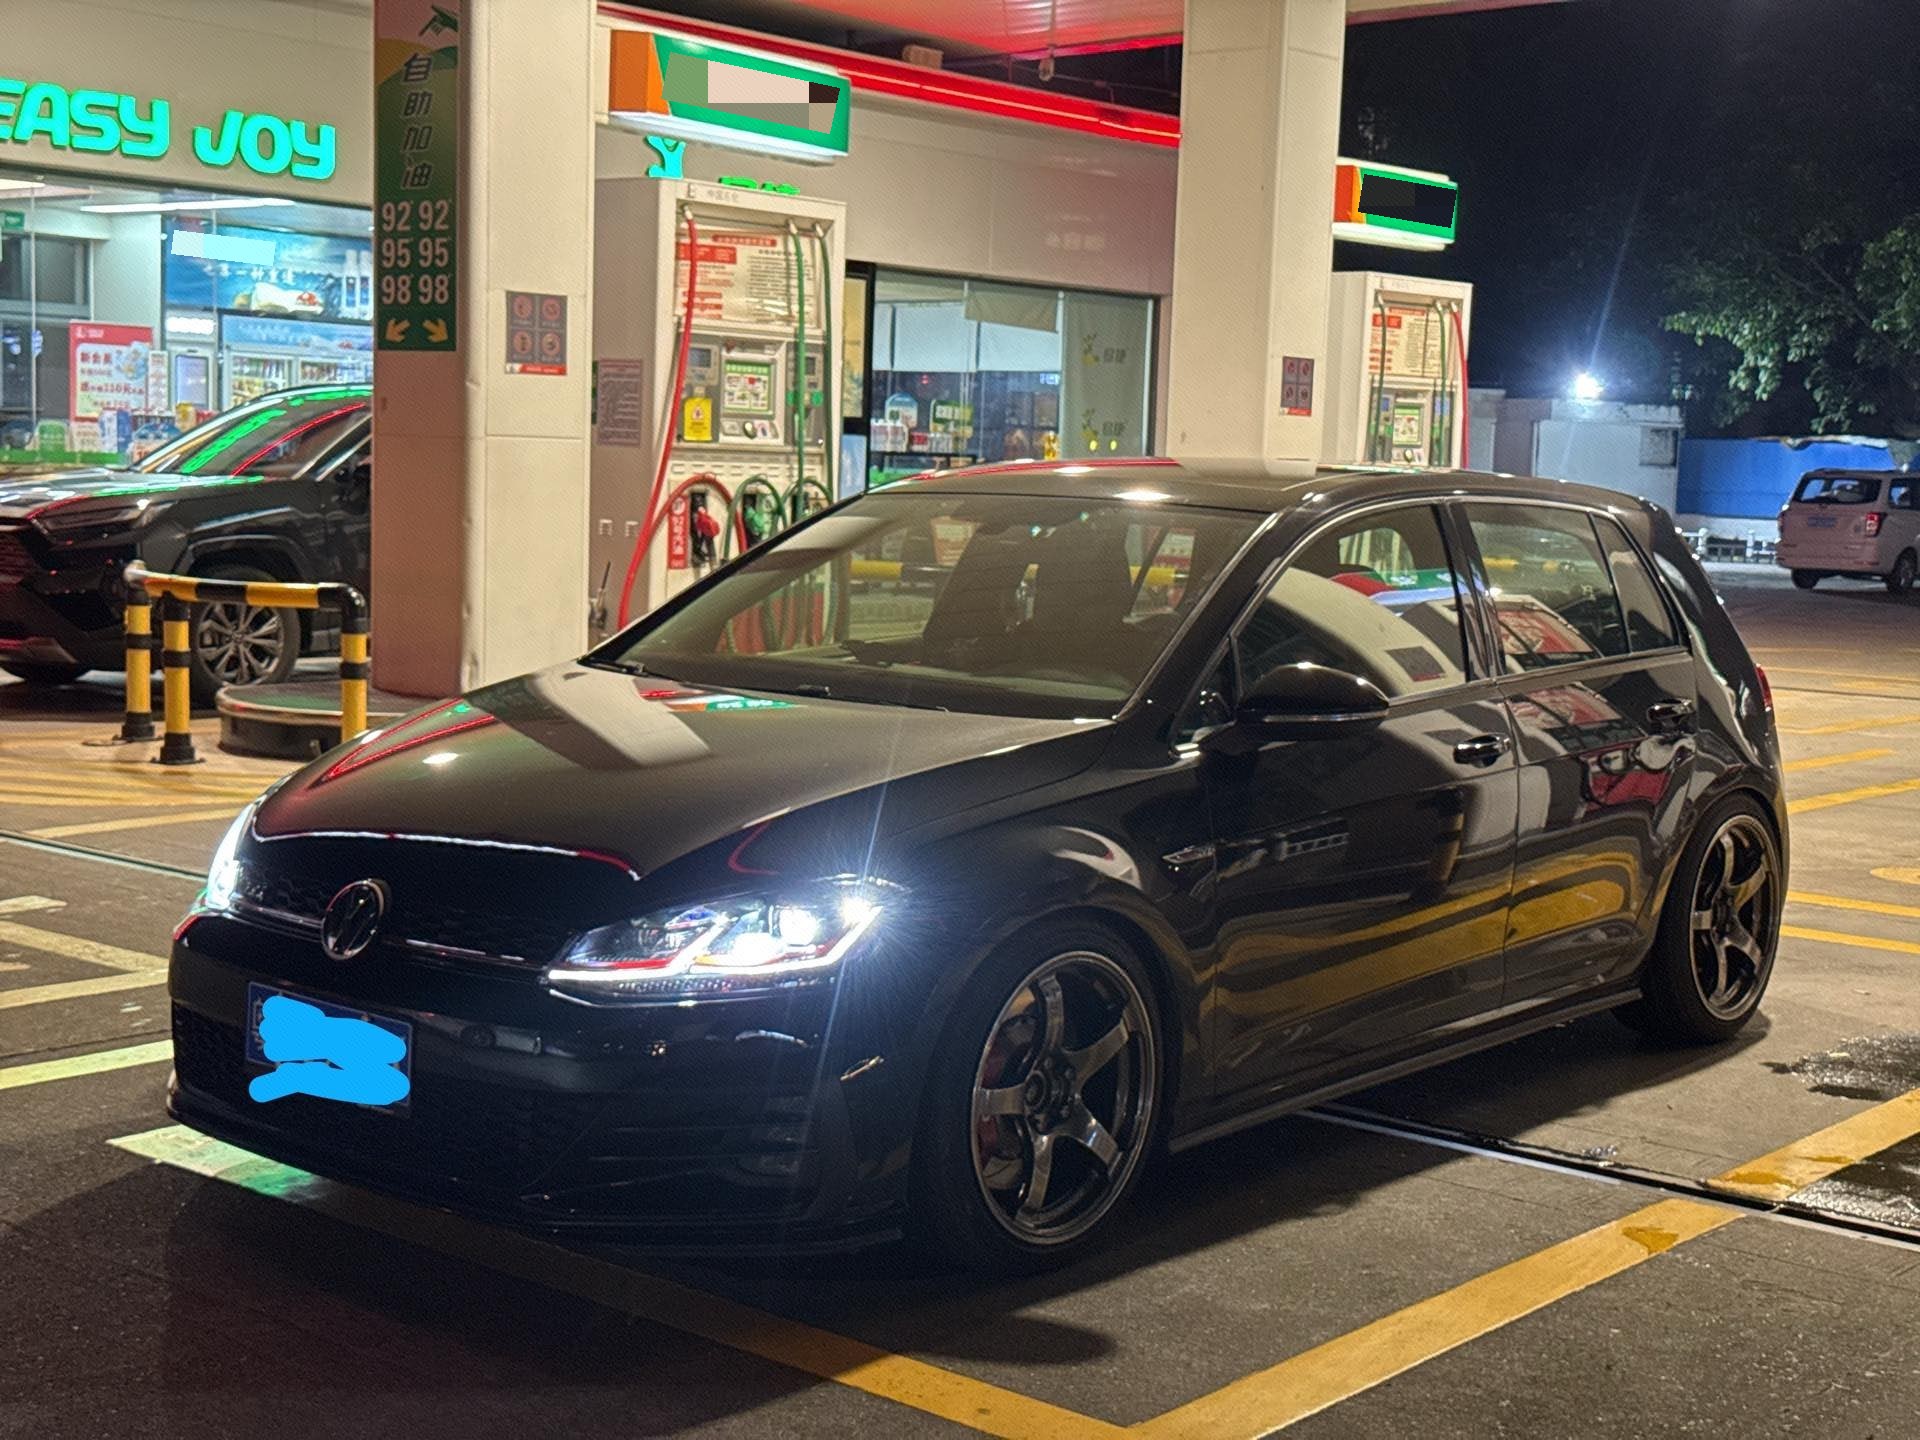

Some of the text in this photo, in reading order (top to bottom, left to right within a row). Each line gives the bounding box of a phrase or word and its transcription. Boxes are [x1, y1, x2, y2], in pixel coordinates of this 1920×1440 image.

[0, 78, 336, 180] EASY JOY
[402, 52, 433, 189] 自助加油
[382, 200, 449, 232] 92 92
[382, 237, 449, 268] 95 95
[382, 274, 449, 305] 98 98
